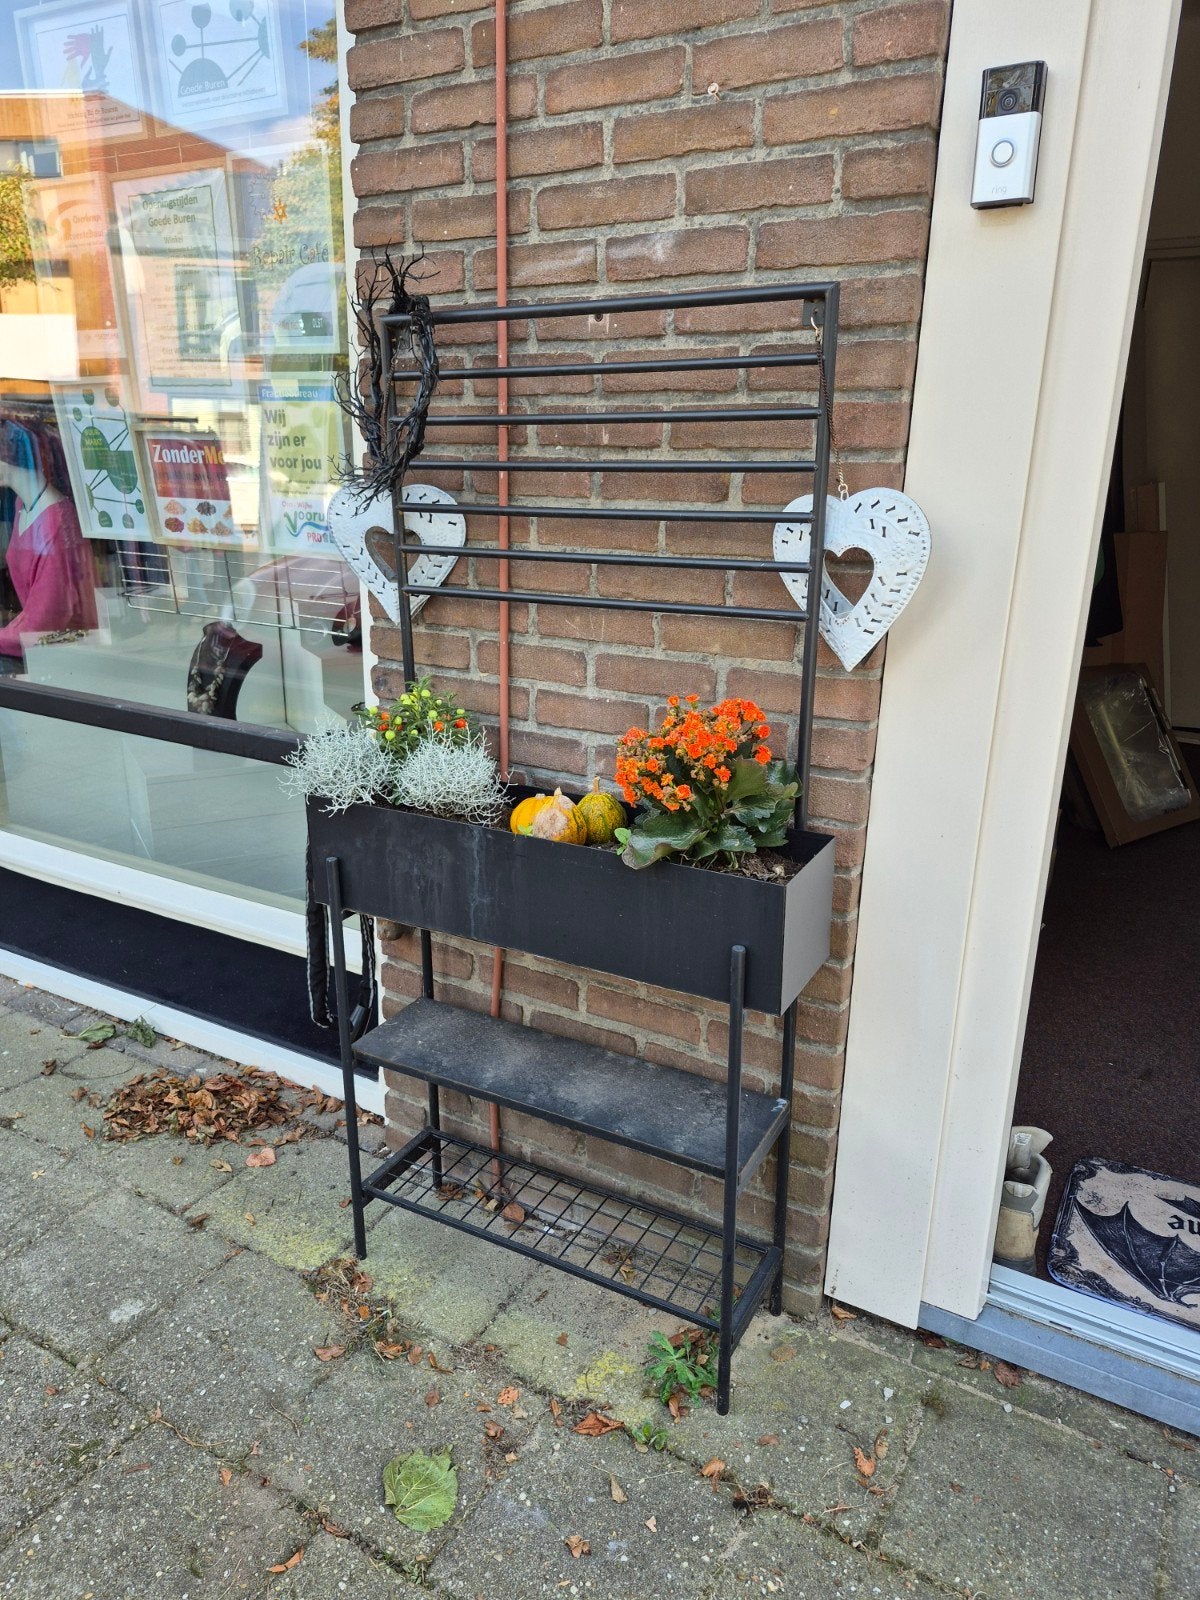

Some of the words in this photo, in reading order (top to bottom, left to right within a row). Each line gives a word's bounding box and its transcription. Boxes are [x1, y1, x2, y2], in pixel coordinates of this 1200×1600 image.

[204, 79, 226, 90] Buren
[991, 184, 1007, 194] ring
[142, 195, 198, 212] Openingstijden
[148, 214, 171, 227] Goede
[173, 213, 196, 223] Buren
[252, 246, 295, 269] Repair
[264, 408, 287, 428] Wij
[267, 431, 291, 450] zijn
[292, 435, 307, 447] er
[270, 457, 297, 469] voor
[301, 454, 322, 473] jou
[284, 511, 326, 533] Vooru
